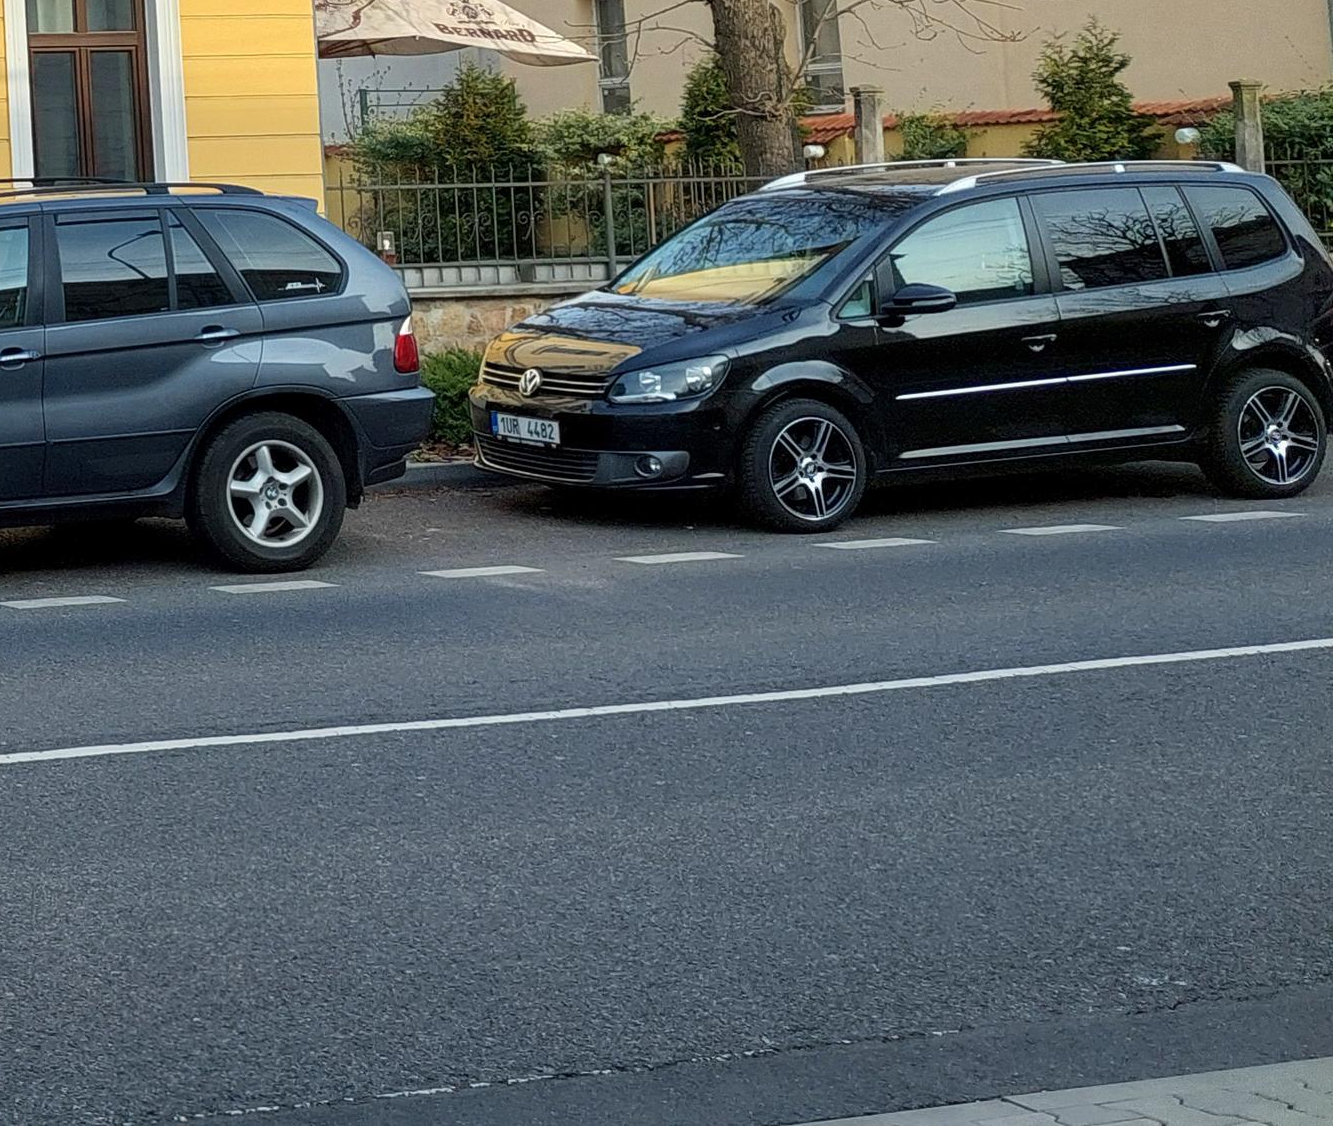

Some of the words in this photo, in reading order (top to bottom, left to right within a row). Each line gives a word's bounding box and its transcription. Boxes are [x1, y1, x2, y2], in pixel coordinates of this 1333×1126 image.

[431, 21, 537, 42] BERNARD
[501, 417, 520, 435] 1UR
[527, 421, 555, 440] 4482
